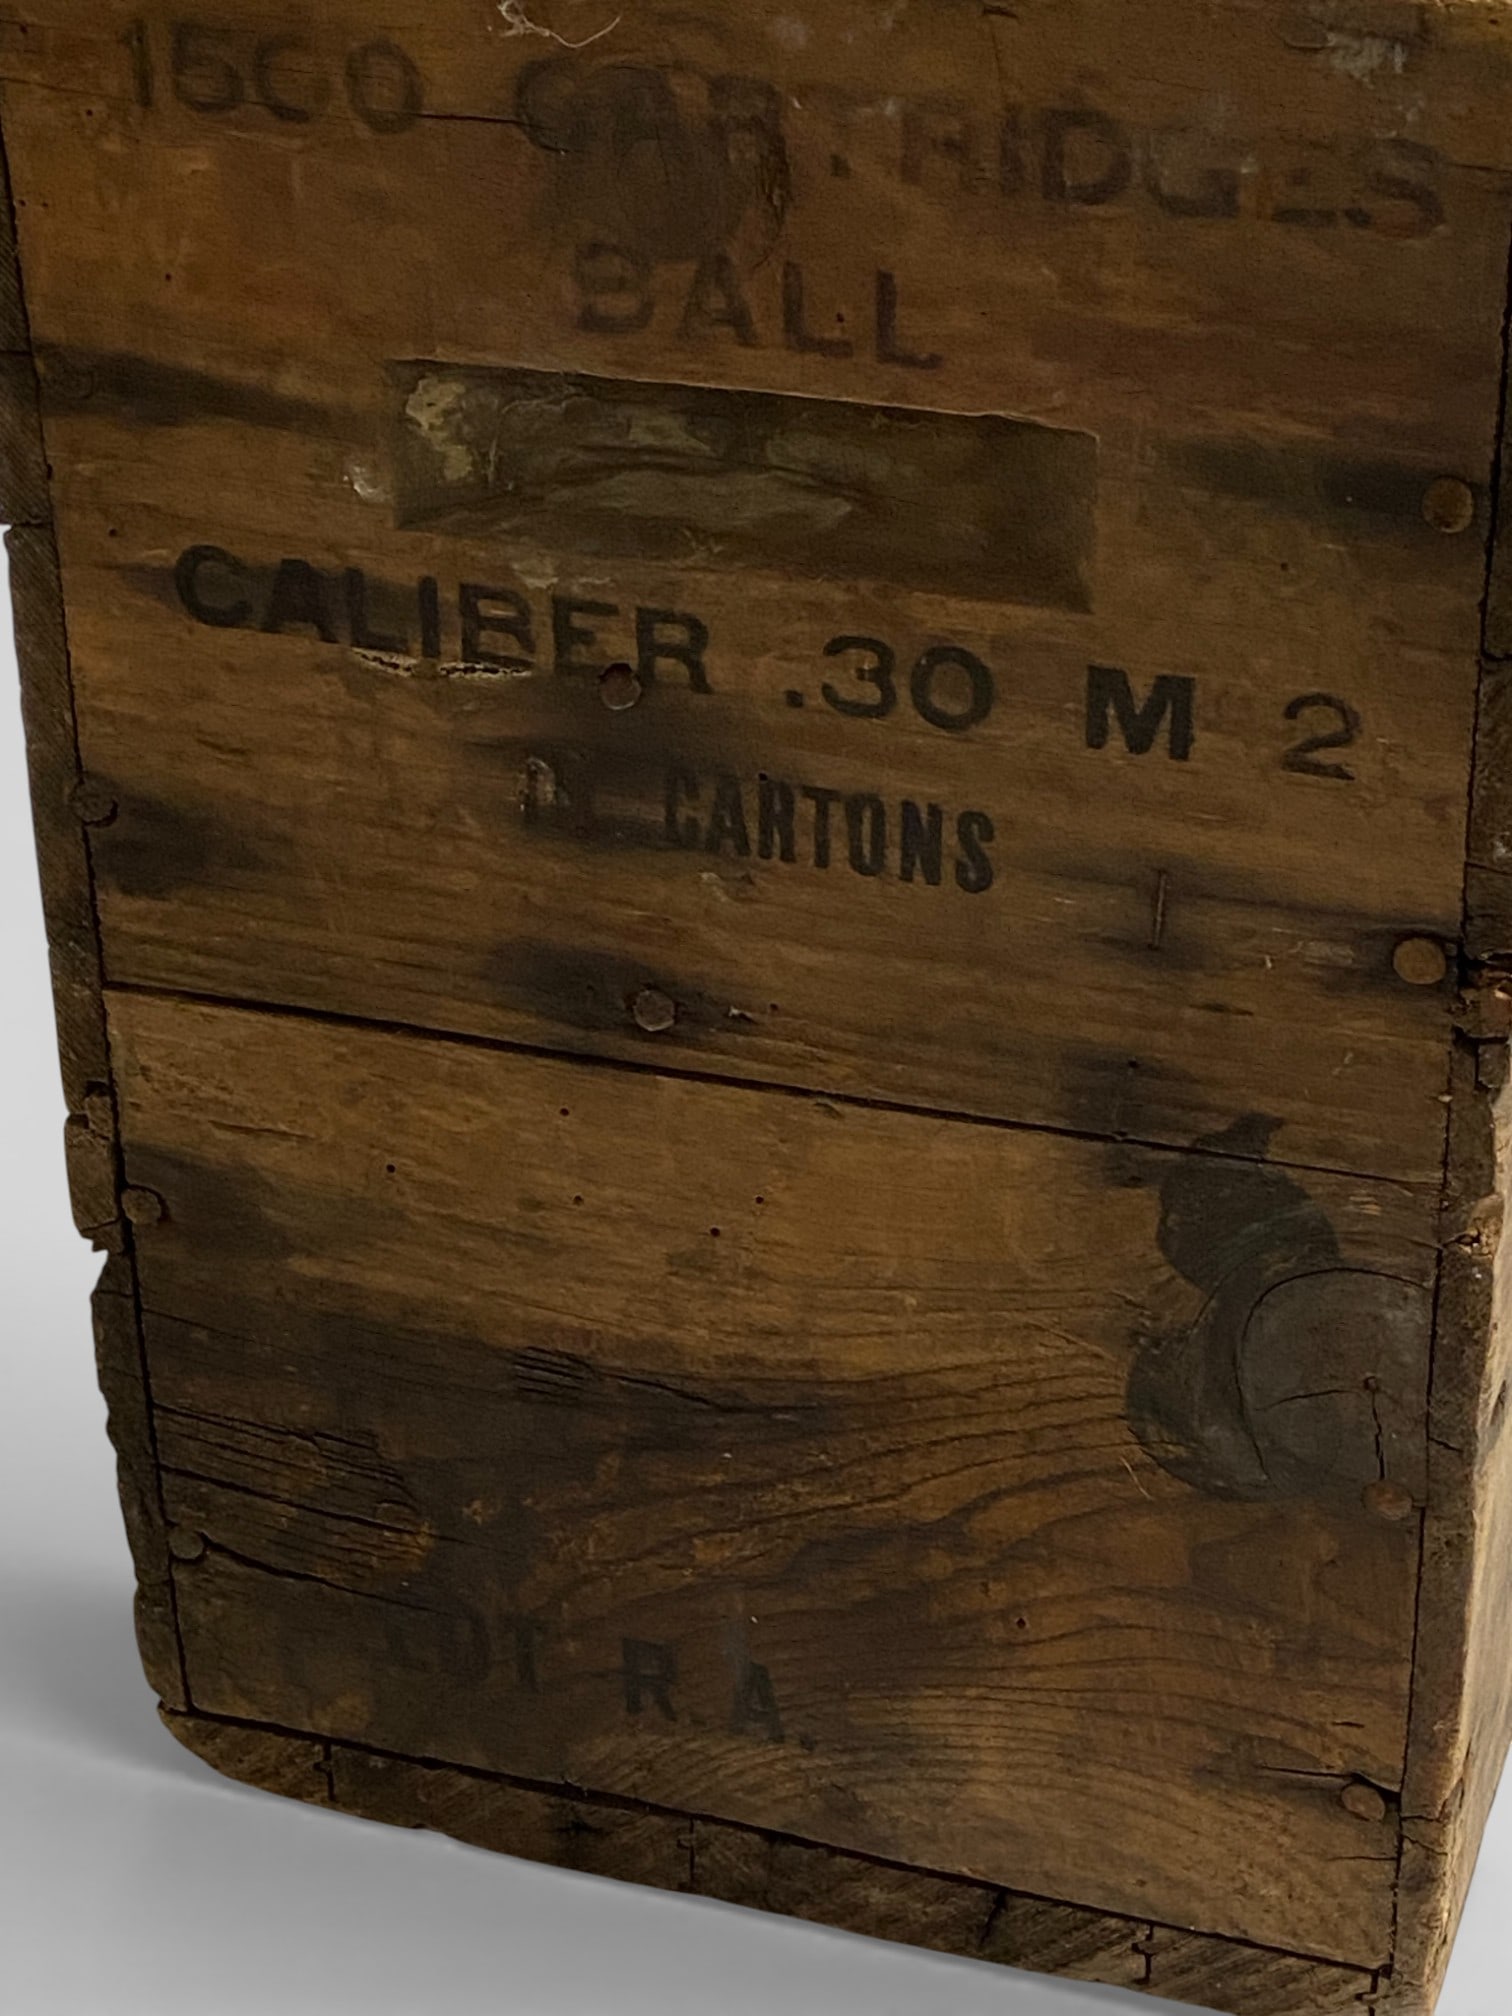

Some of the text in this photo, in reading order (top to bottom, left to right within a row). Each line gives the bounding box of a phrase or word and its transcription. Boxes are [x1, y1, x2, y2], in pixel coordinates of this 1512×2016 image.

[574, 241, 943, 370] BALL
[174, 543, 1362, 781] CALIBER .30 M 2
[664, 765, 996, 894] CARTONS
